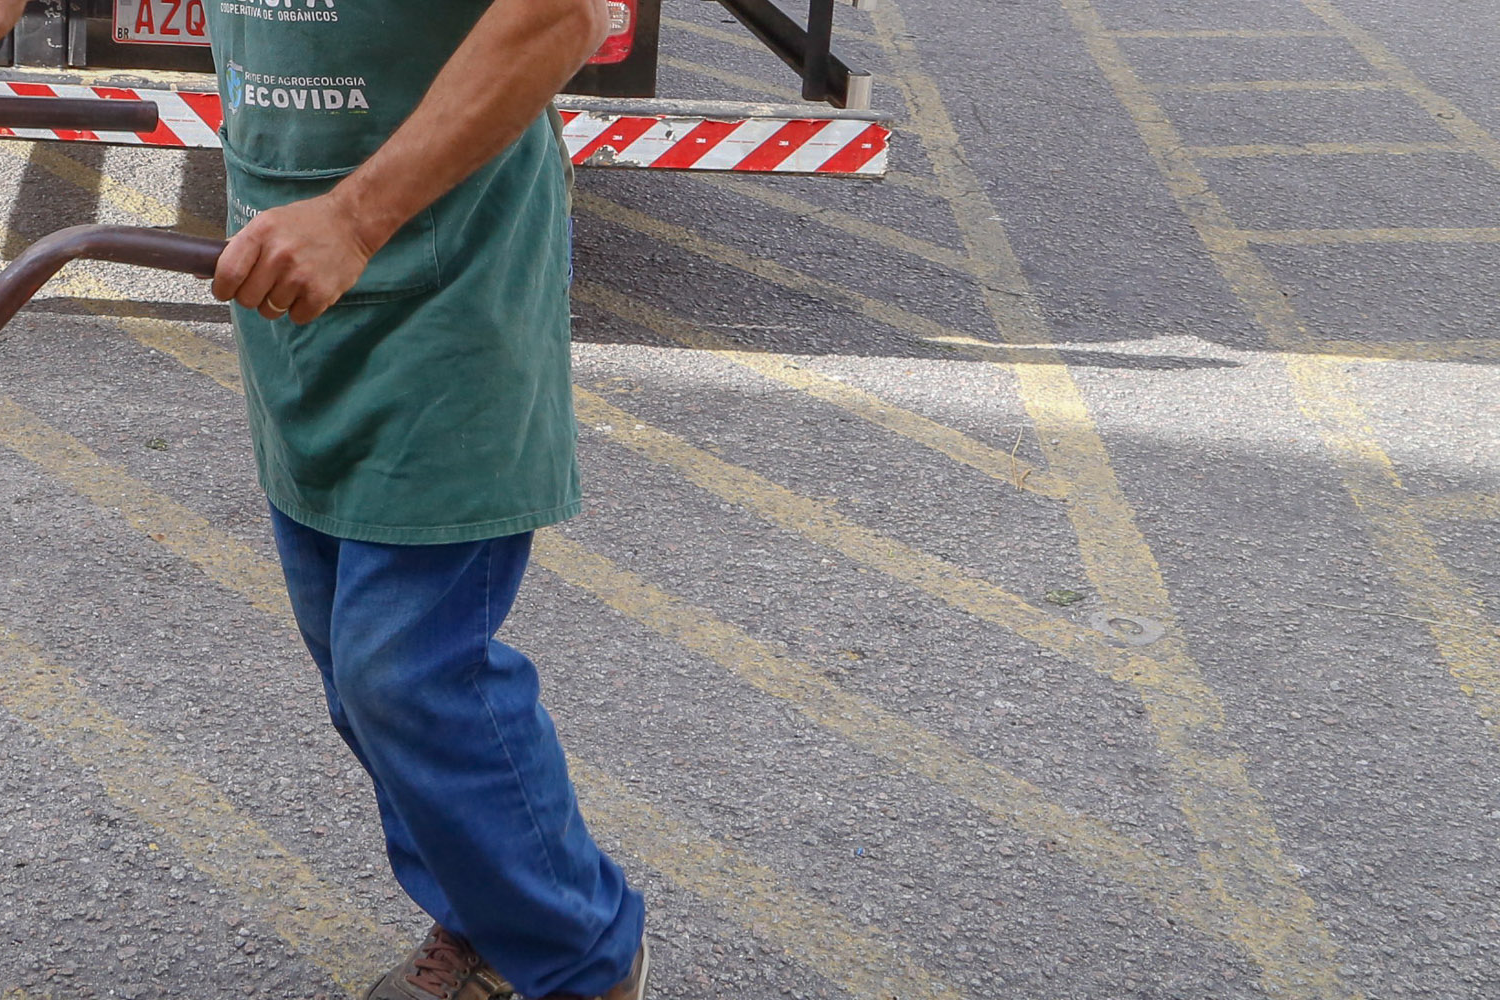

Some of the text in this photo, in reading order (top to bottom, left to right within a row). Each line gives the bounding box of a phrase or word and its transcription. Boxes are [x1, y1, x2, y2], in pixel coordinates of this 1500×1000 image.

[262, 9, 274, 21] DE
[277, 8, 338, 22] ORGÂNICOS
[117, 27, 129, 39] BR
[263, 74, 276, 85] DE
[278, 76, 367, 87] AGROECOLOGIA
[244, 84, 370, 110] ECOVIDA
